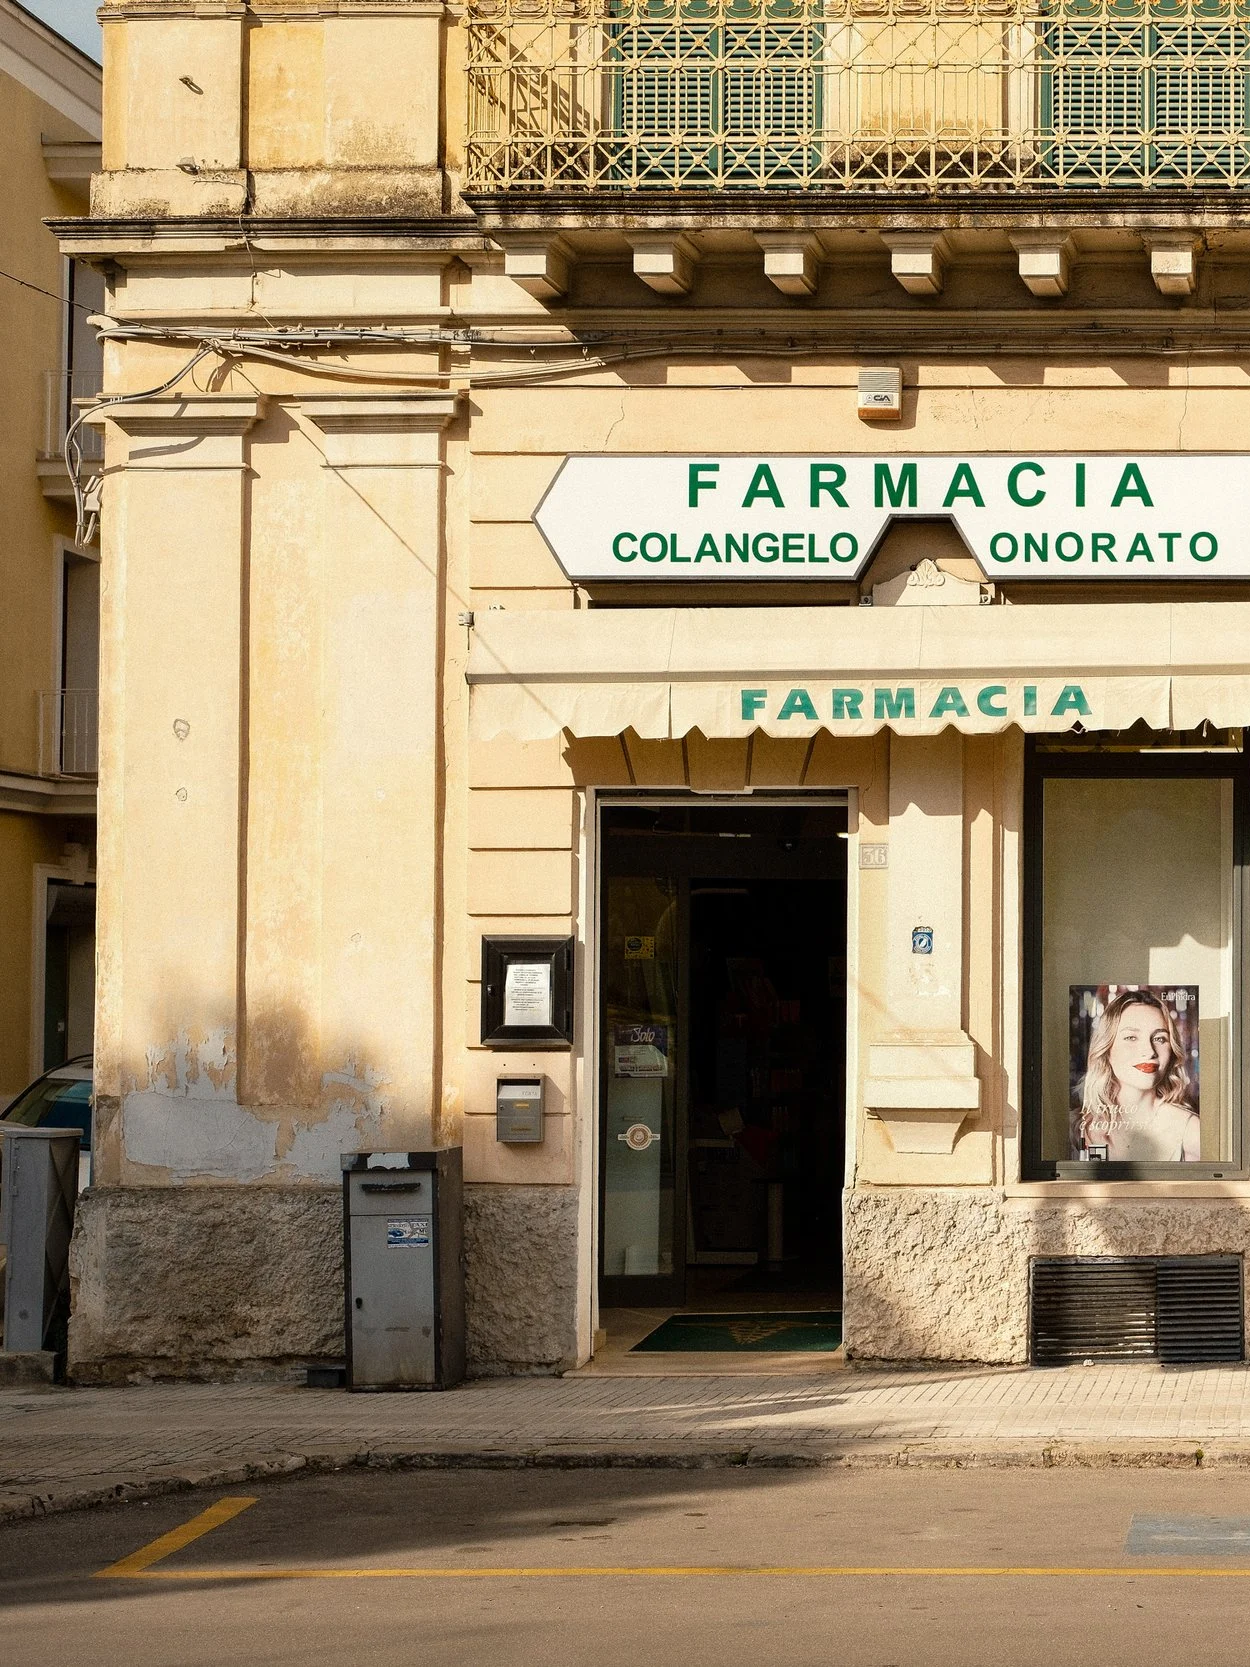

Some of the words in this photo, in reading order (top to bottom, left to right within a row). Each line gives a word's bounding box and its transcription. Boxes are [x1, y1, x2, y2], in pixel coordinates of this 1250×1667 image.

[688, 462, 1154, 508] FARMACIA
[612, 532, 858, 562] COLANGELO
[990, 532, 1218, 562] ONORATO
[742, 686, 1091, 720] FARMACIA
[1096, 1104, 1138, 1114] trucco
